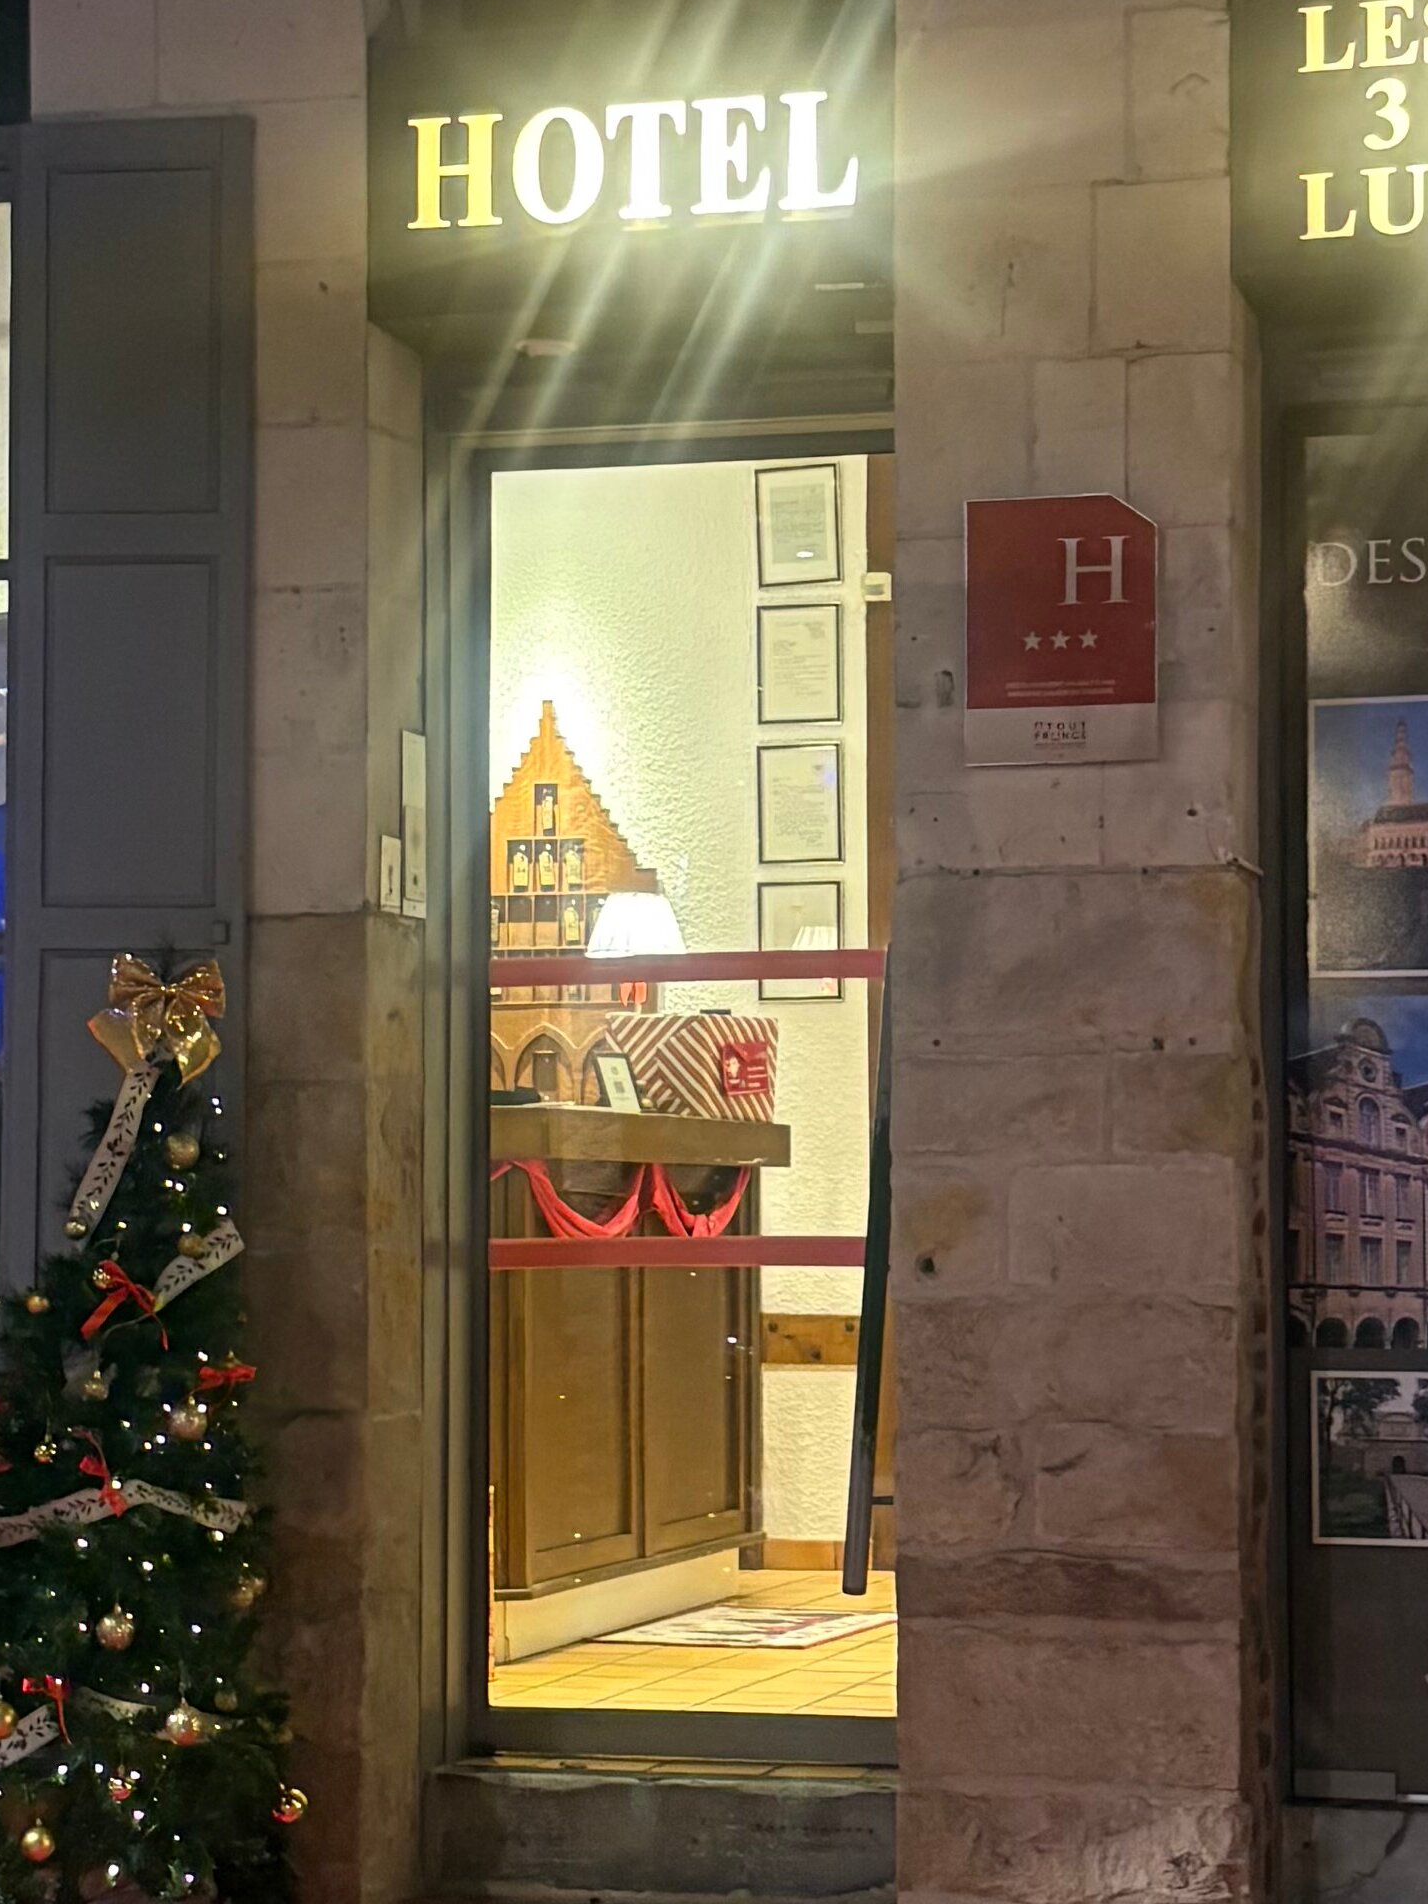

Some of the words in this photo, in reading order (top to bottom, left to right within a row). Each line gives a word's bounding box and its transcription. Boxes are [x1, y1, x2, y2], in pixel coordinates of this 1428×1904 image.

[1363, 78, 1411, 151] 3
[407, 91, 859, 229] HOTEL
[1057, 535, 1131, 606] H
[1314, 536, 1428, 587] DES
